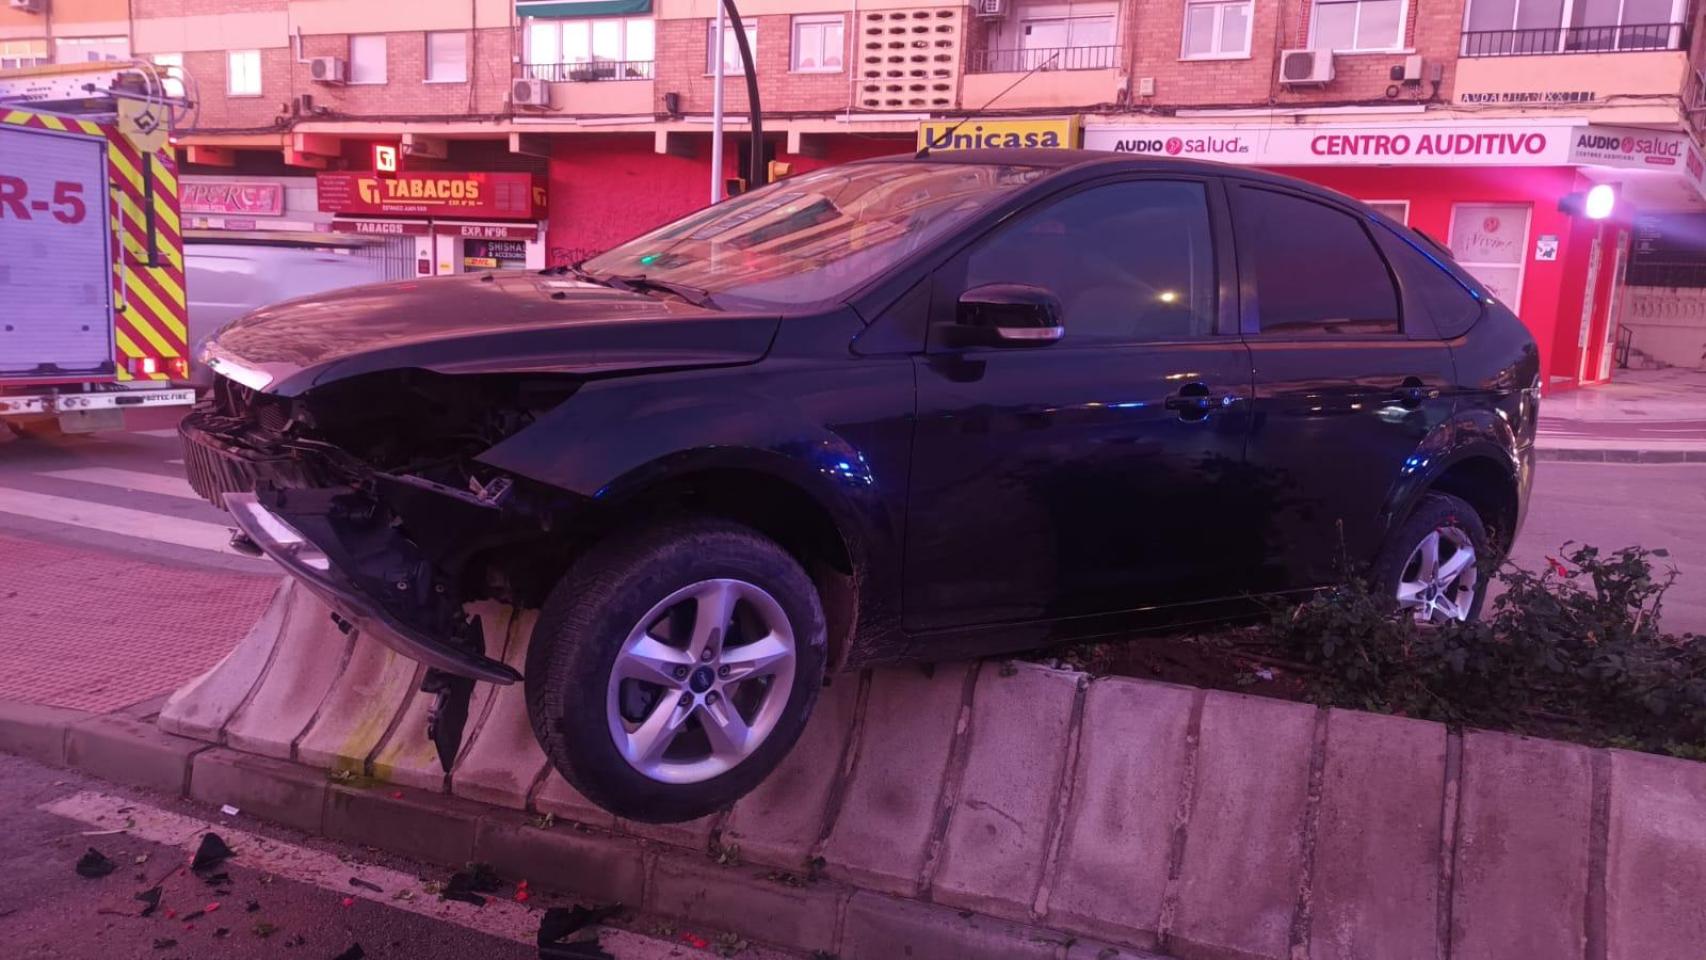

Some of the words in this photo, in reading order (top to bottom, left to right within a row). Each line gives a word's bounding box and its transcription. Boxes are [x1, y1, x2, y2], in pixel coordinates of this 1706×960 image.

[925, 126, 1061, 150] Unicasa
[1114, 140, 1163, 152] AUDIO
[1311, 135, 1411, 155] CENTRO
[1415, 133, 1547, 155] AUDITIVO
[1577, 134, 1620, 150] AUDIO
[385, 179, 479, 199] TABACOS
[356, 222, 403, 233] TABACOS
[461, 226, 482, 237] EXP.
